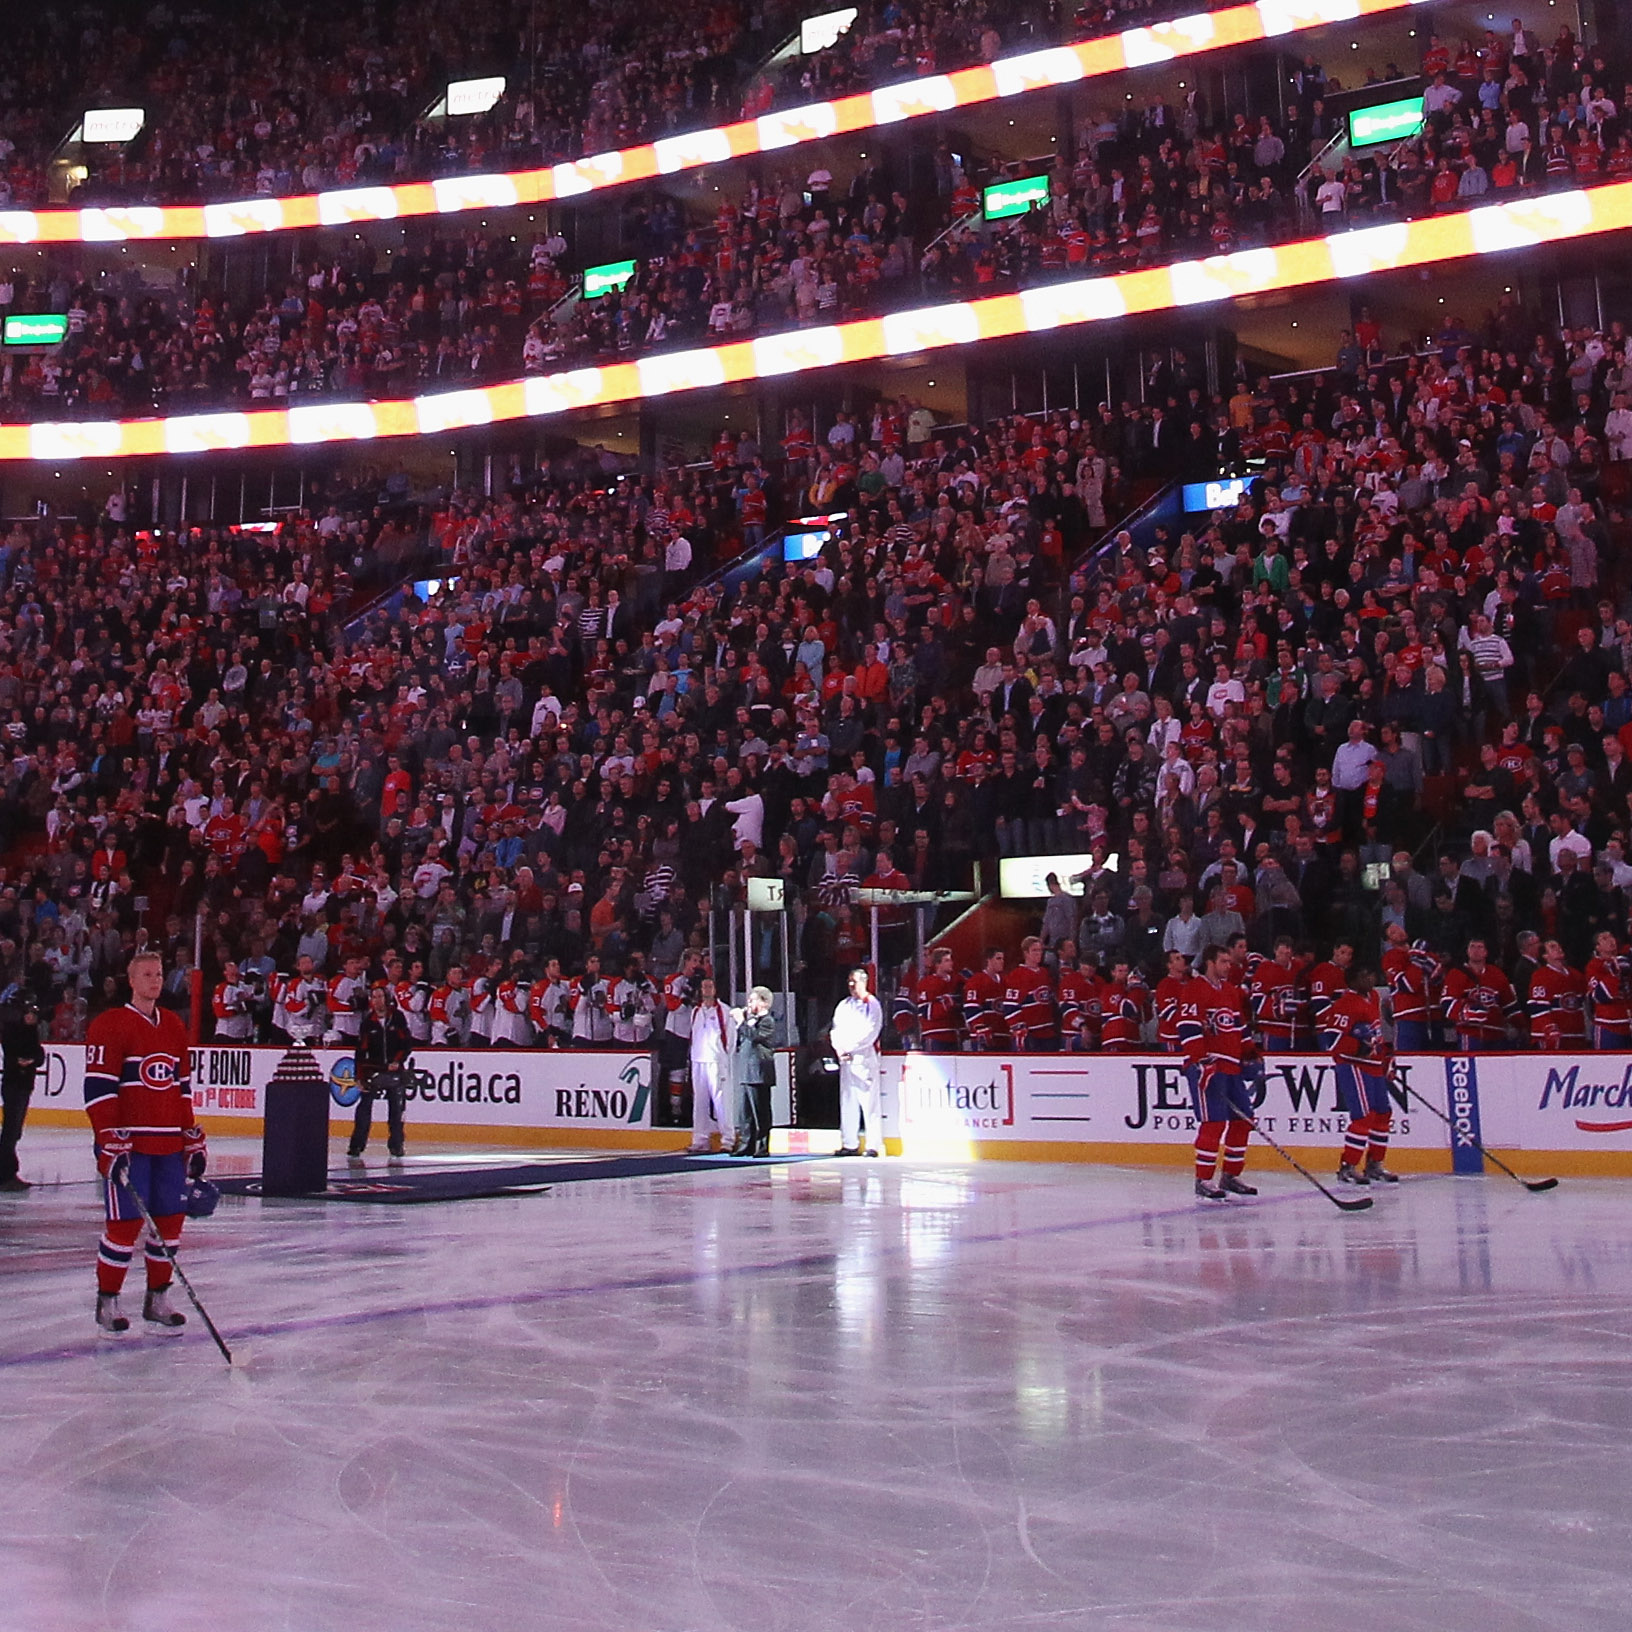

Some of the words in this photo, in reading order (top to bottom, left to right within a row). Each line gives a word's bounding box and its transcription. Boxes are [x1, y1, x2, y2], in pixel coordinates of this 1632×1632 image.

[1181, 1003, 1198, 1016] 24
[1333, 1013, 1349, 1027] 76
[209, 1050, 252, 1085] BOND
[555, 1083, 627, 1119] RÉNO
[1450, 1055, 1473, 1147] Reebok
